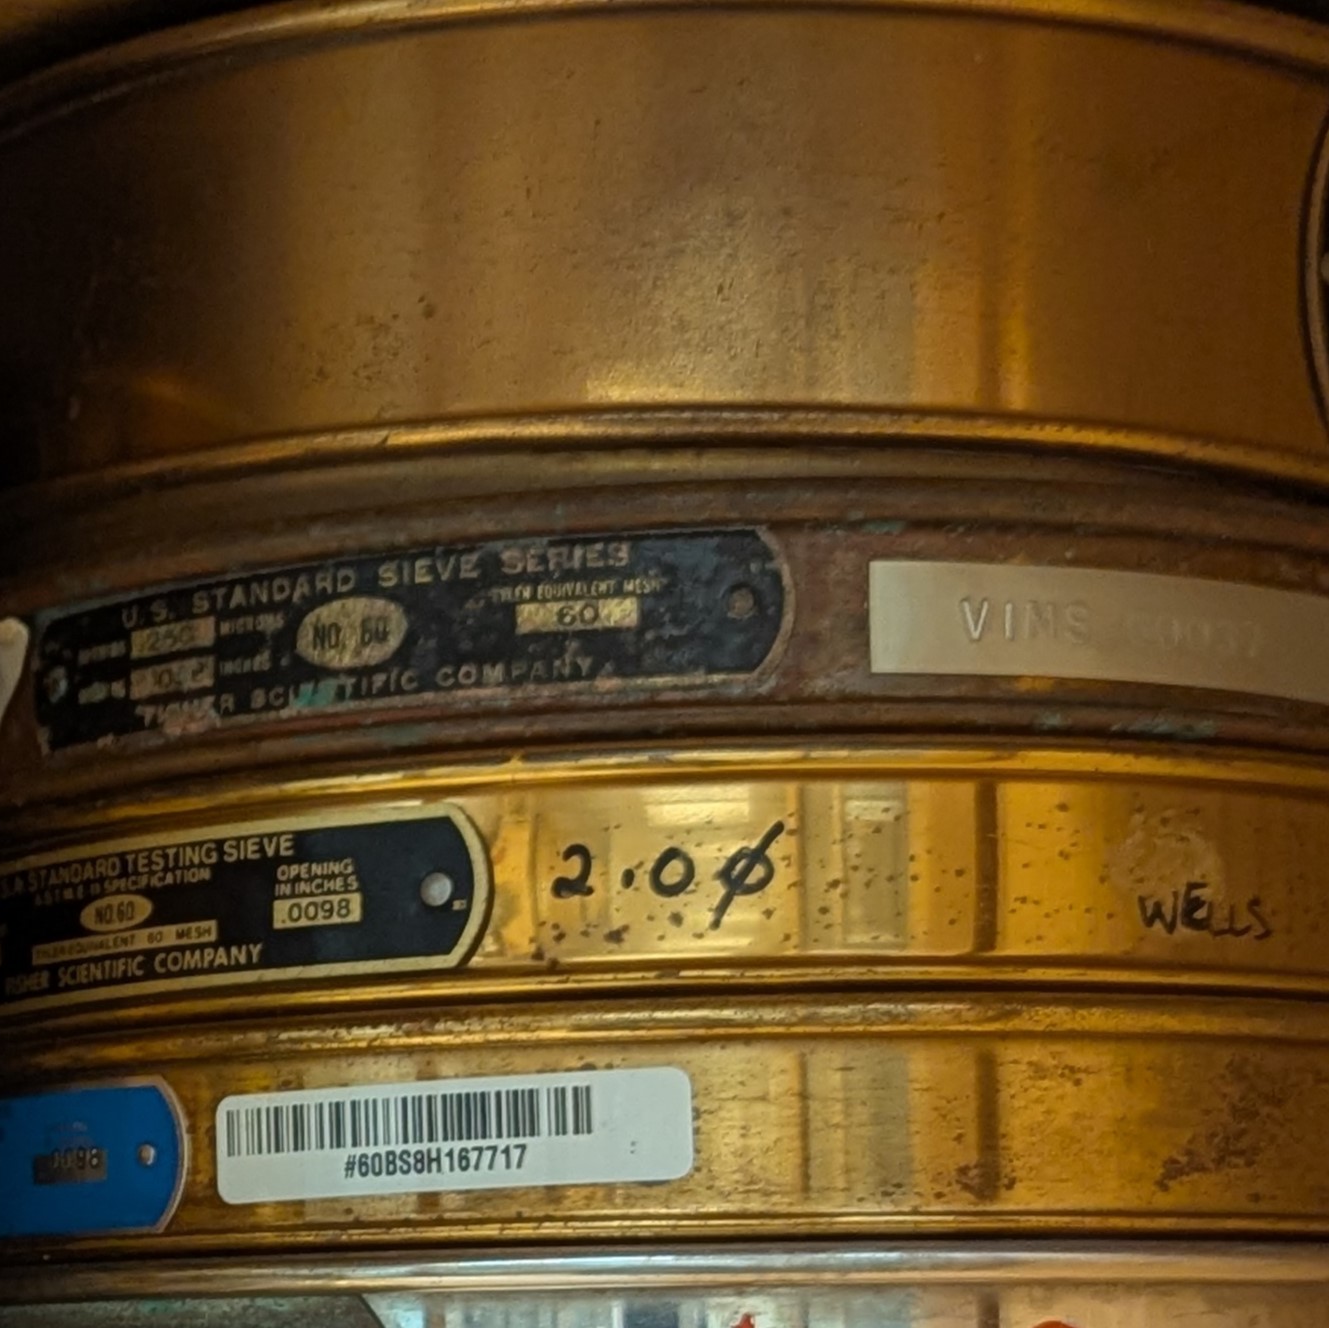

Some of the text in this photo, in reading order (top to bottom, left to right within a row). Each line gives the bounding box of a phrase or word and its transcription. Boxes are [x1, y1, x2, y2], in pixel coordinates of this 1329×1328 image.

[193, 541, 633, 614] STANDARD SIEVE SERIES
[556, 605, 599, 627] 60
[436, 656, 594, 688] COMPANY
[28, 834, 296, 893] STANDARD TESTING SIEVE
[276, 857, 355, 881] OPENING
[103, 866, 212, 895] SPECIFICATION
[274, 875, 359, 898] IN INCHES
[175, 925, 213, 942] MESH
[57, 955, 147, 988] SCIENTIFIC
[154, 942, 265, 976] COMPANY
[343, 1143, 530, 1180] #60BS8H167717
